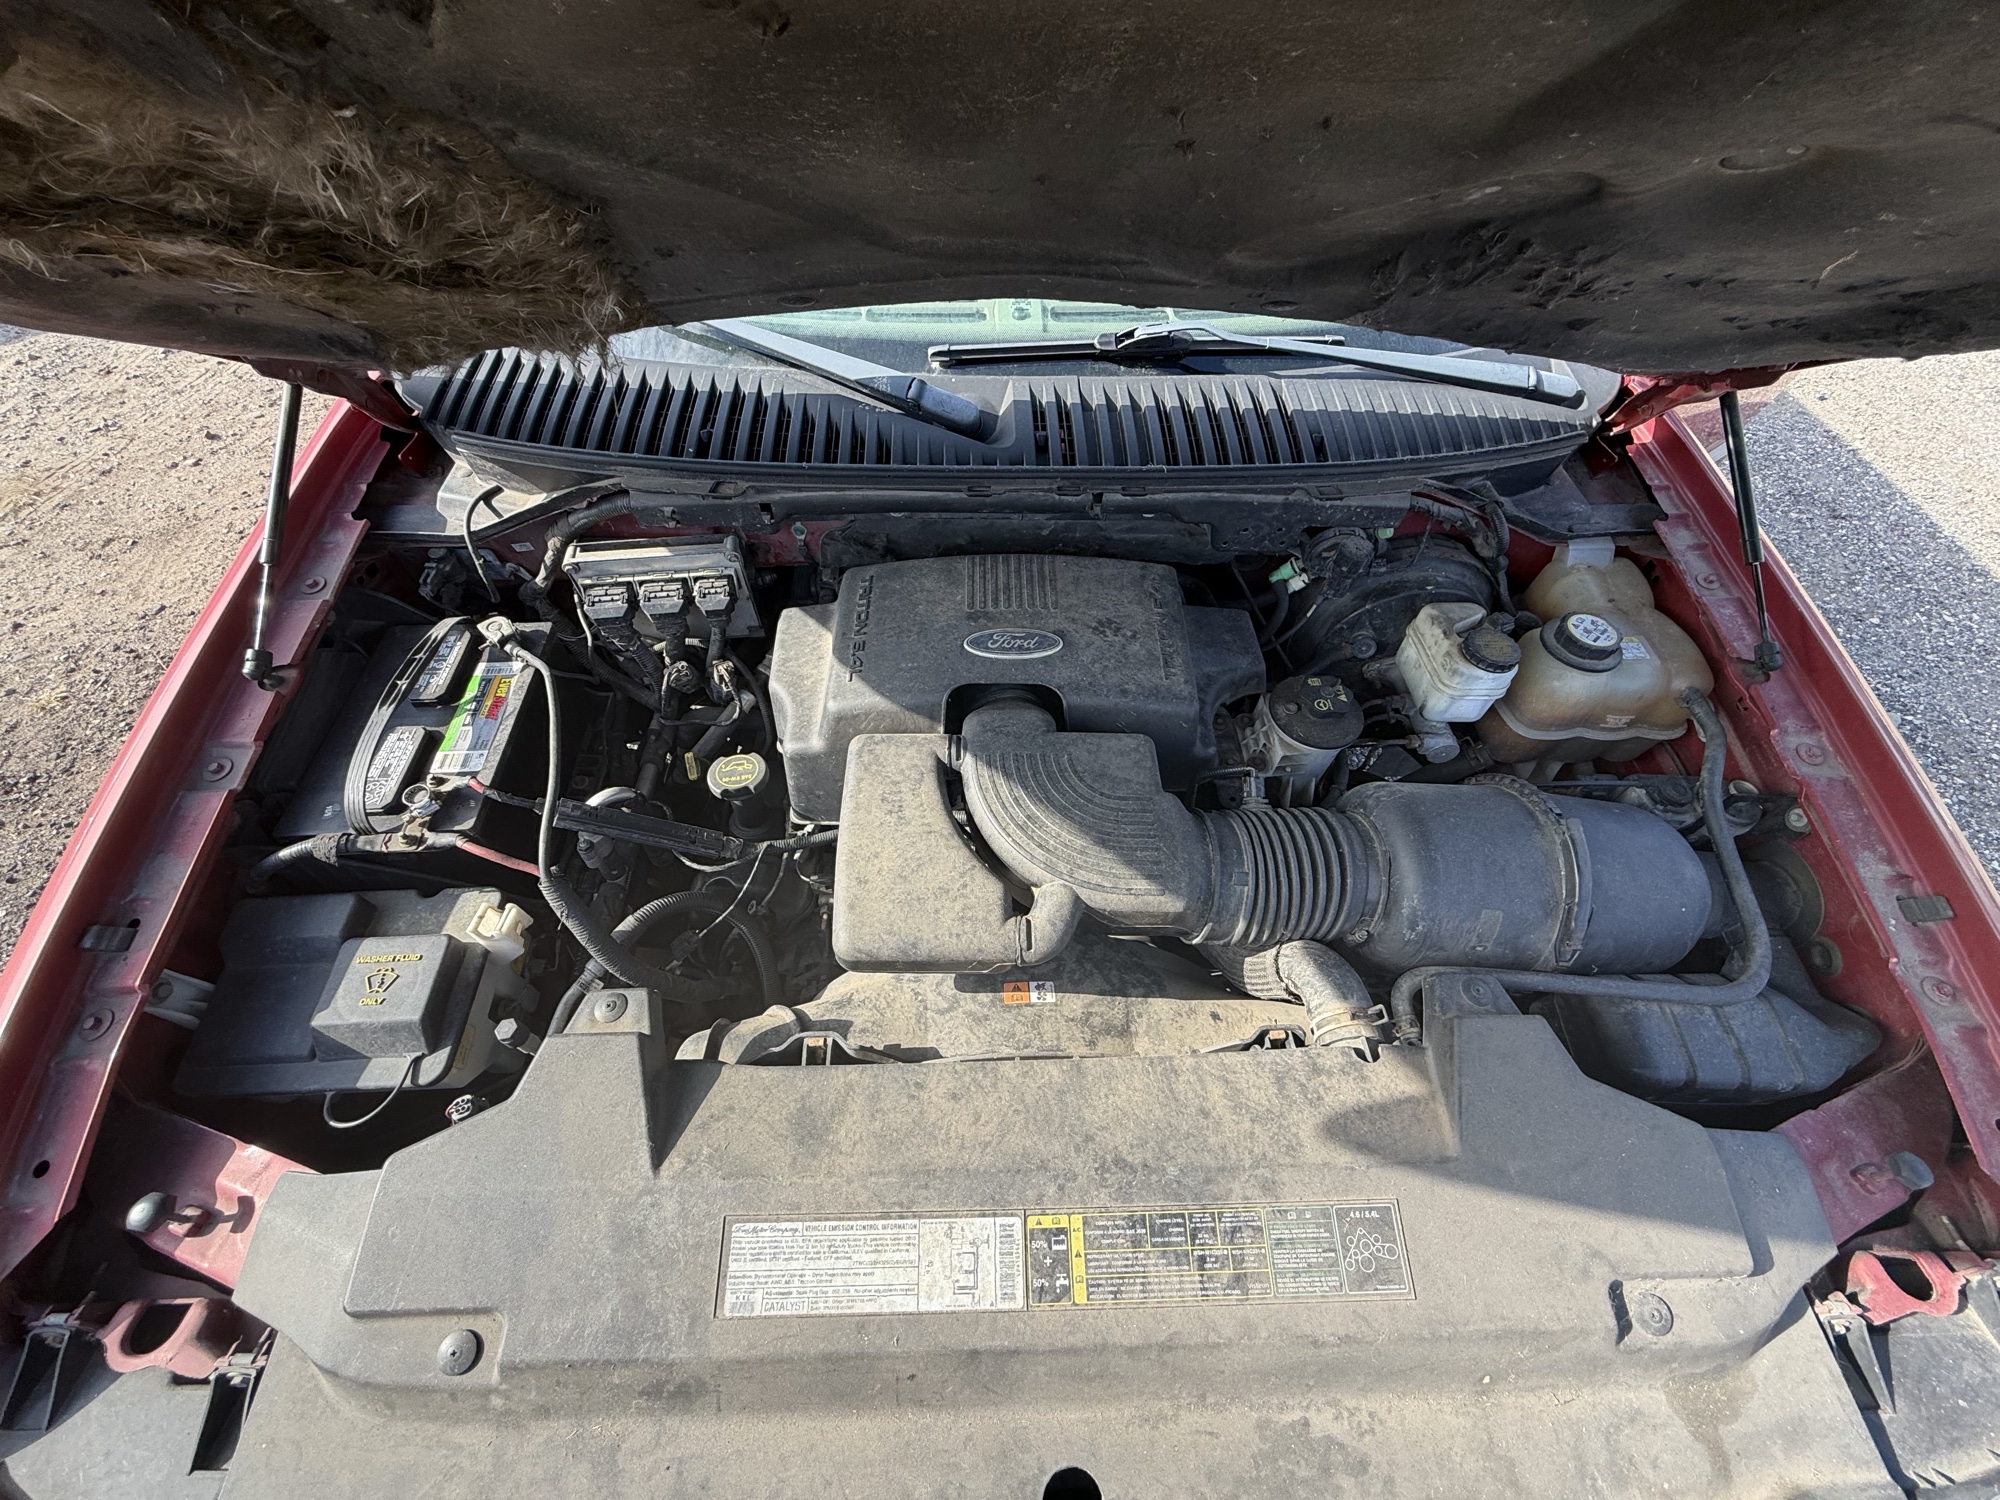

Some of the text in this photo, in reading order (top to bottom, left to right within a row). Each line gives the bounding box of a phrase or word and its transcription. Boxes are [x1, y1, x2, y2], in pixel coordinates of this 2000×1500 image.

[852, 574, 874, 637] TRITON
[988, 632, 1039, 648] Ford
[485, 677, 512, 721] EverStart
[356, 954, 422, 964] WASHER FLUID
[359, 997, 384, 1006] ONLY
[804, 1224, 827, 1232] VEHICLE
[828, 1224, 854, 1232] EMISSION
[881, 1222, 918, 1230] INFORMATION
[1031, 1240, 1048, 1249] 50%
[1032, 1278, 1050, 1287] 50%
[764, 1300, 806, 1312] CATALYST
